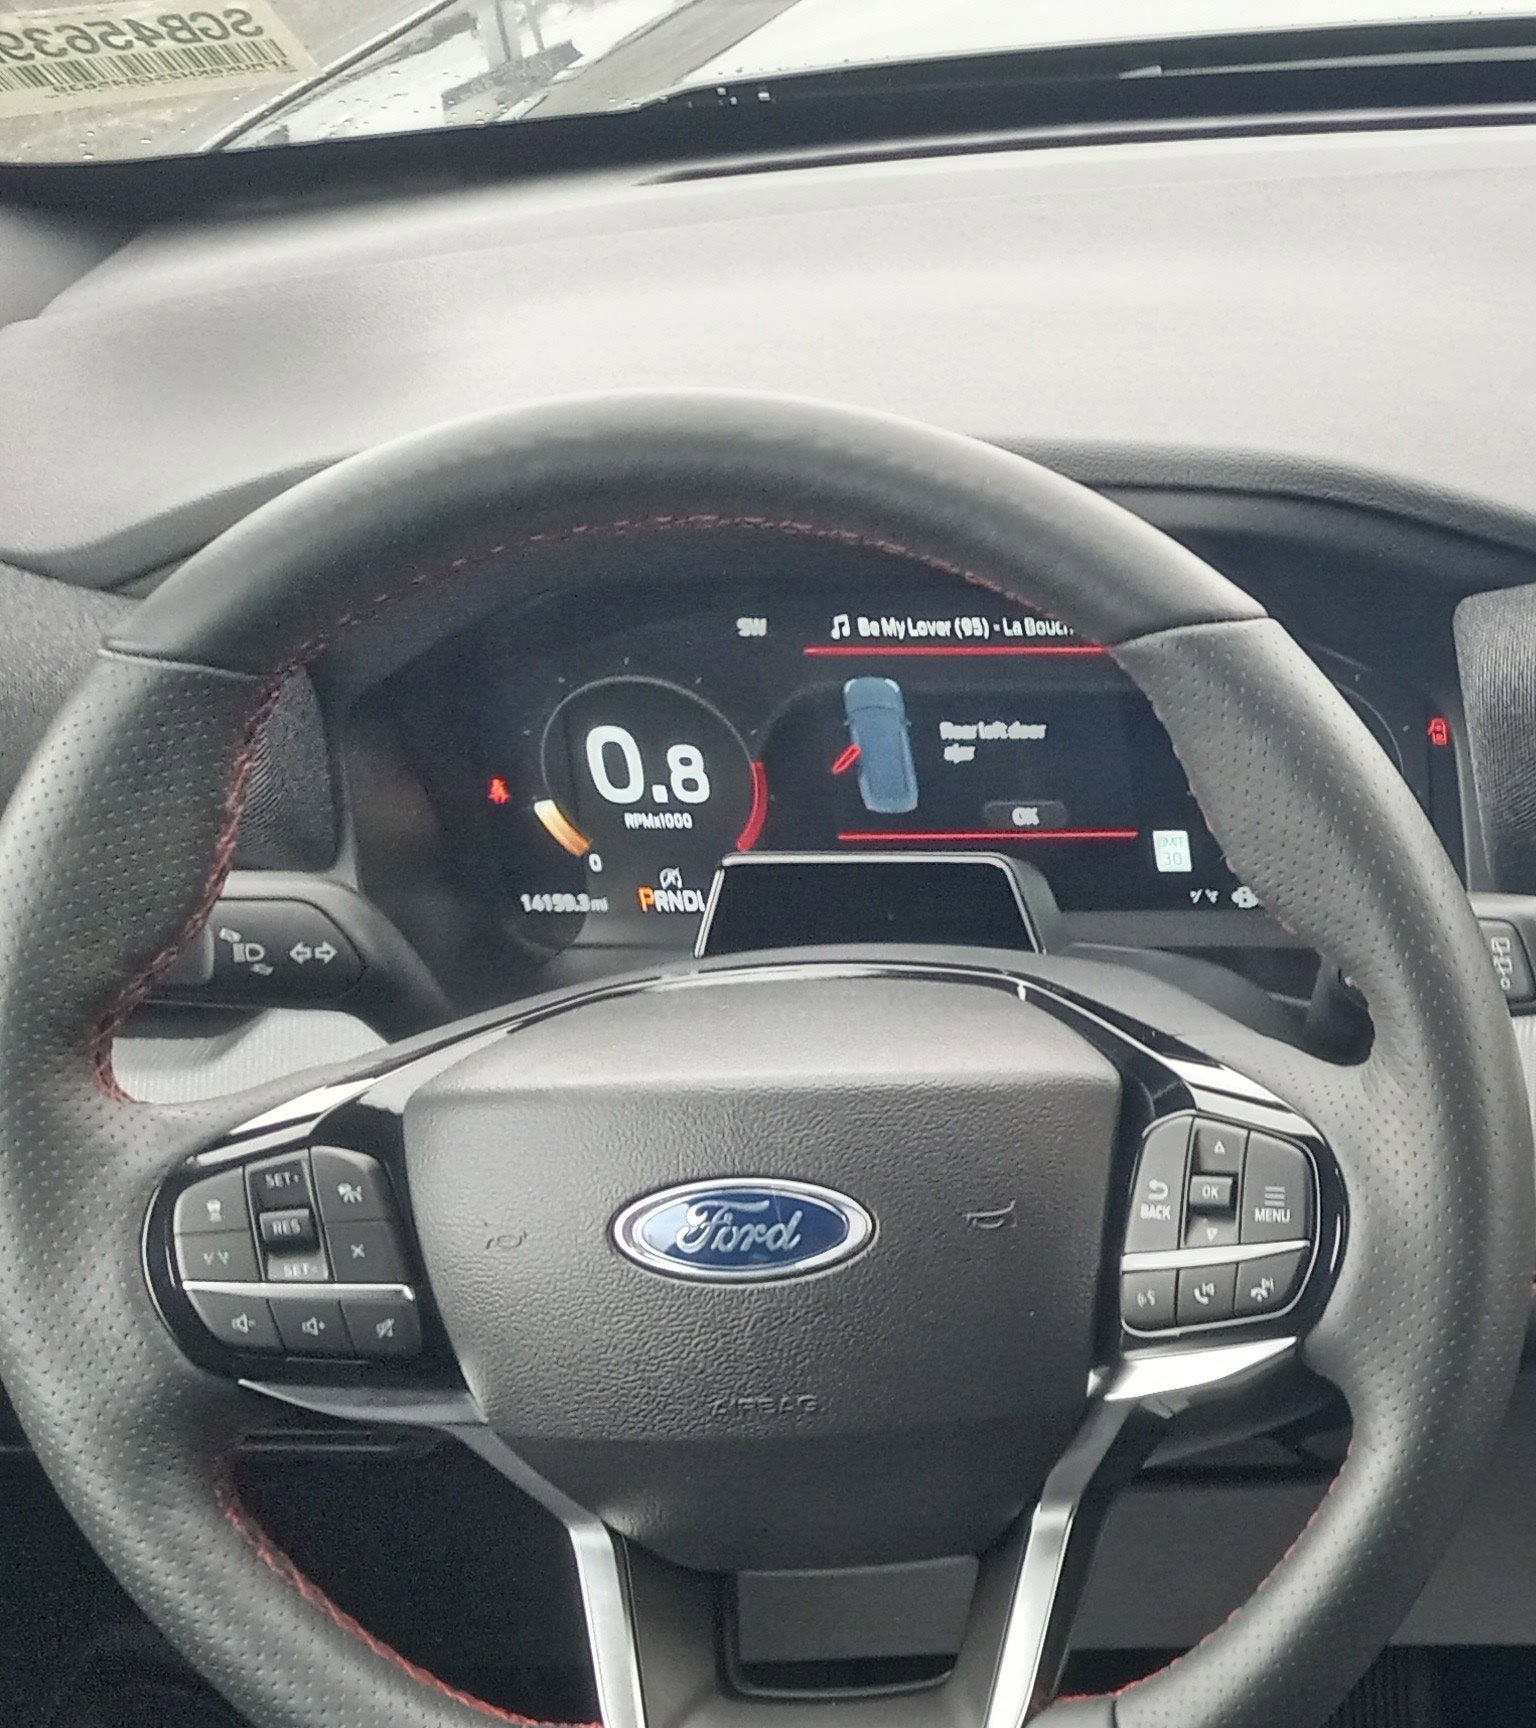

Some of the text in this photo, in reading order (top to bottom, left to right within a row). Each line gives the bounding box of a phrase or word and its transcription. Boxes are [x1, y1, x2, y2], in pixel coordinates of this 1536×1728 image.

[907, 617, 951, 638] Lover
[1024, 617, 1074, 637] Bouc
[586, 725, 710, 804] 0.8
[1162, 851, 1183, 866] 30
[1202, 1185, 1219, 1199] OK
[1140, 1205, 1171, 1221] BACK
[1254, 1208, 1291, 1225] MENU
[676, 1199, 803, 1254] Ford
